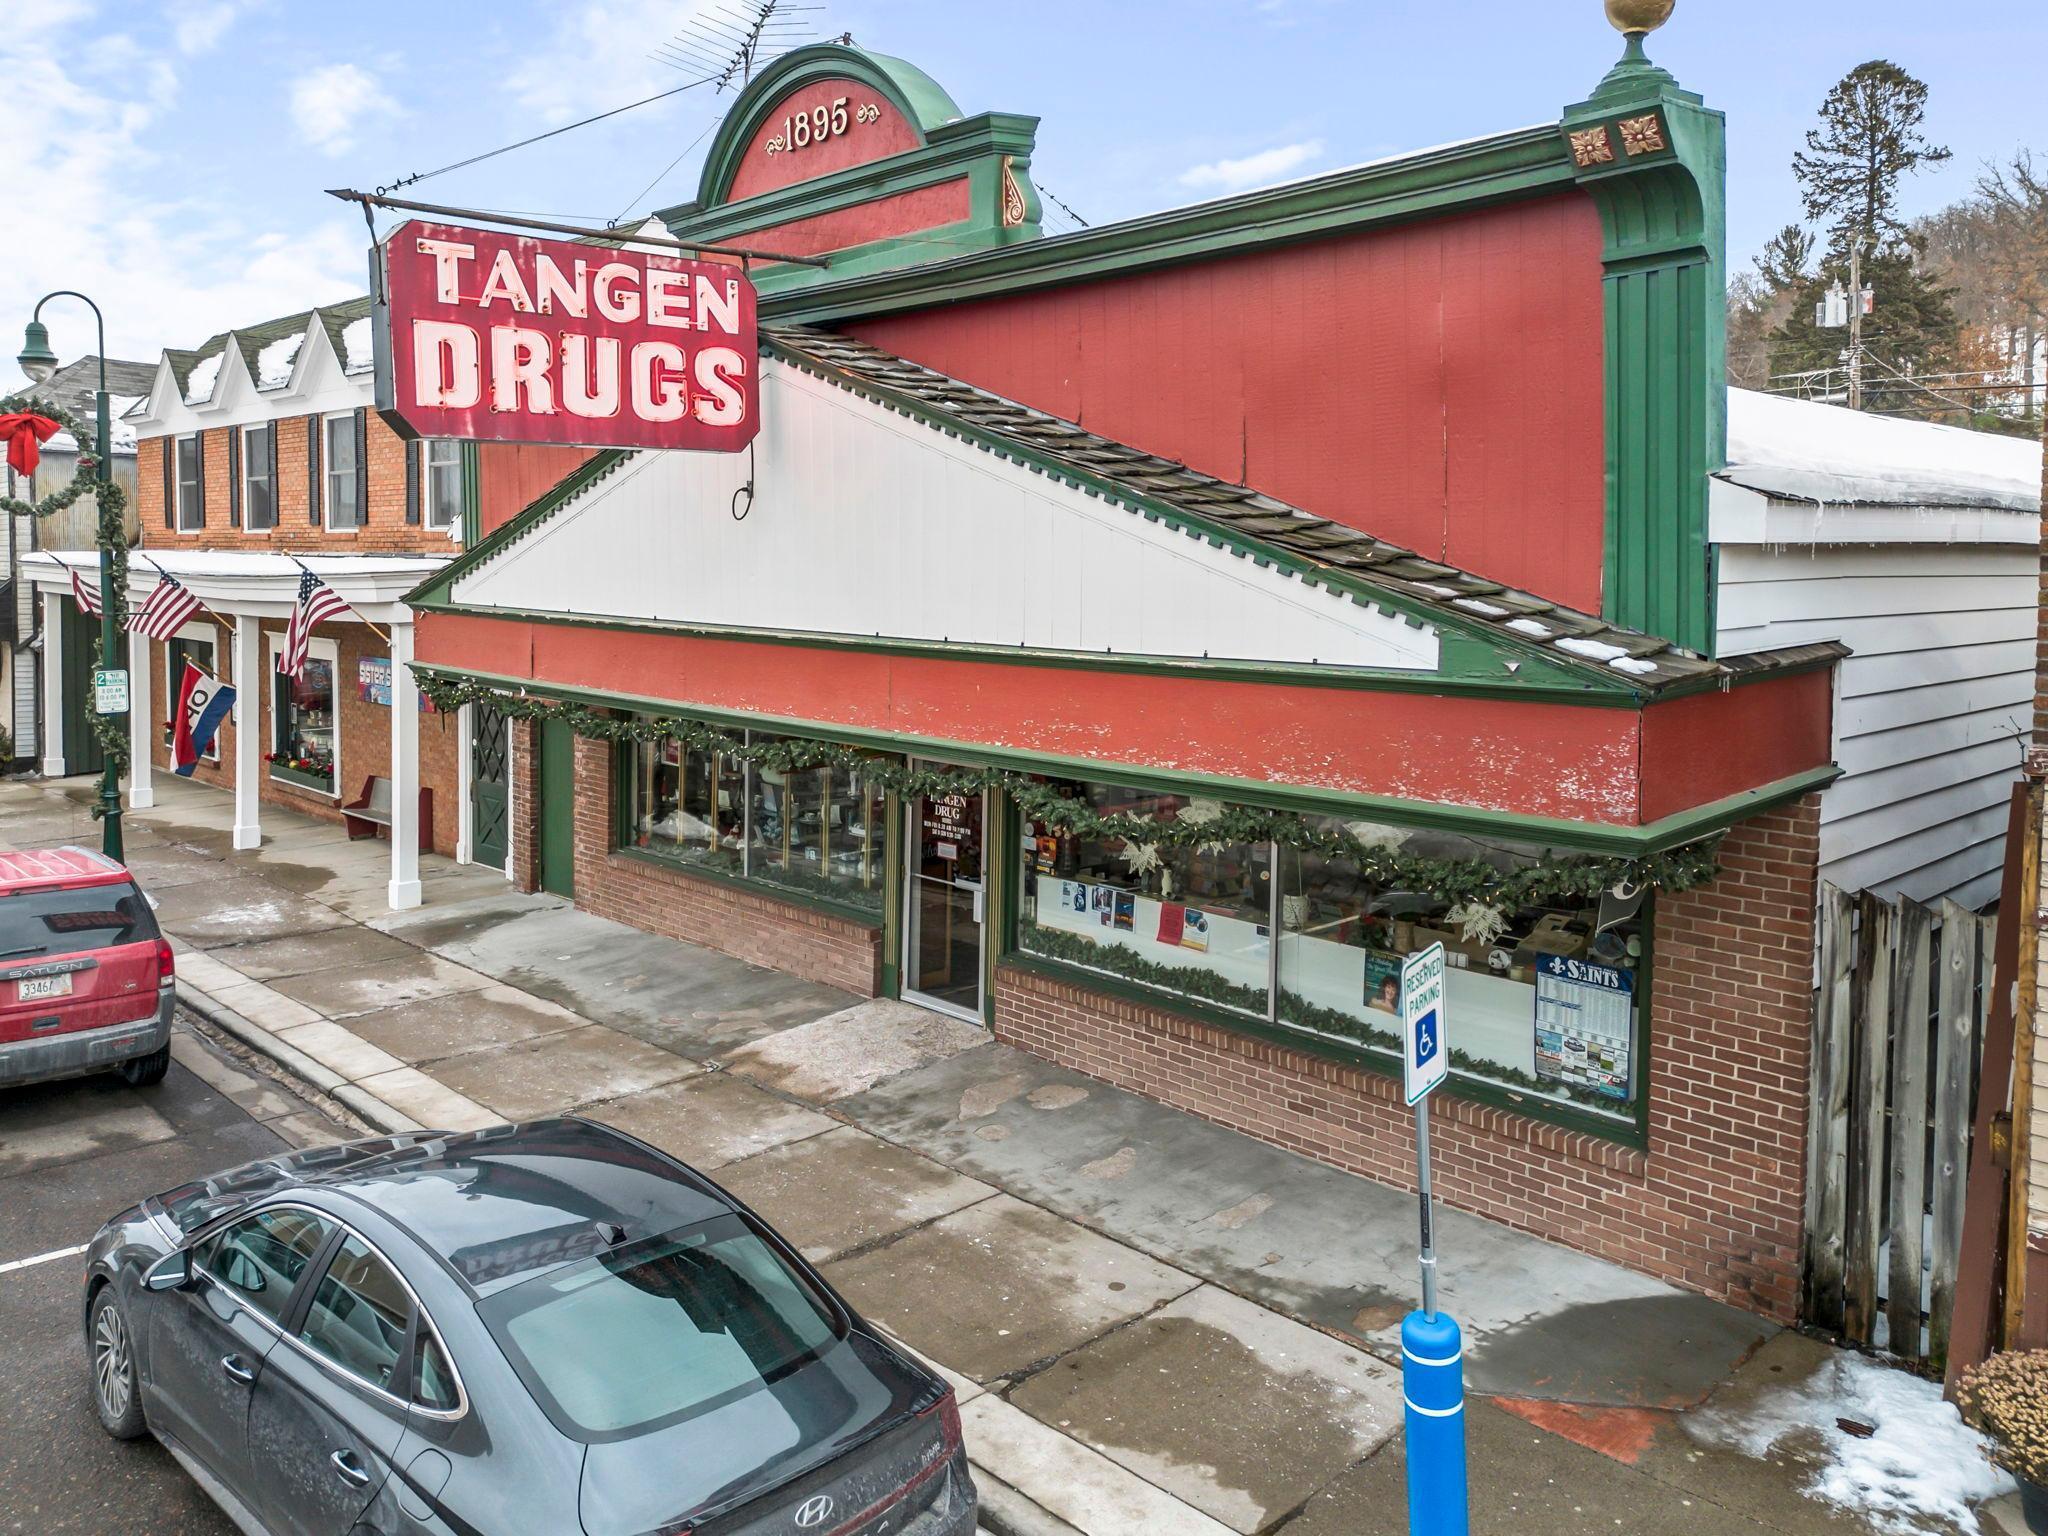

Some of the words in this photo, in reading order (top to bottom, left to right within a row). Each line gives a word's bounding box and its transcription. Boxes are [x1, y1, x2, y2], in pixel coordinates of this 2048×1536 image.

[784, 96, 848, 152] 1895
[416, 237, 739, 335] TANGEN
[413, 319, 746, 426] DRUGS
[97, 674, 105, 685] 2
[935, 805, 960, 819] DRUG
[8, 962, 83, 978] SATURN
[1406, 957, 1441, 995] RESERVED
[1567, 959, 1619, 988] SAINTS
[1409, 981, 1440, 1018] PARKING
